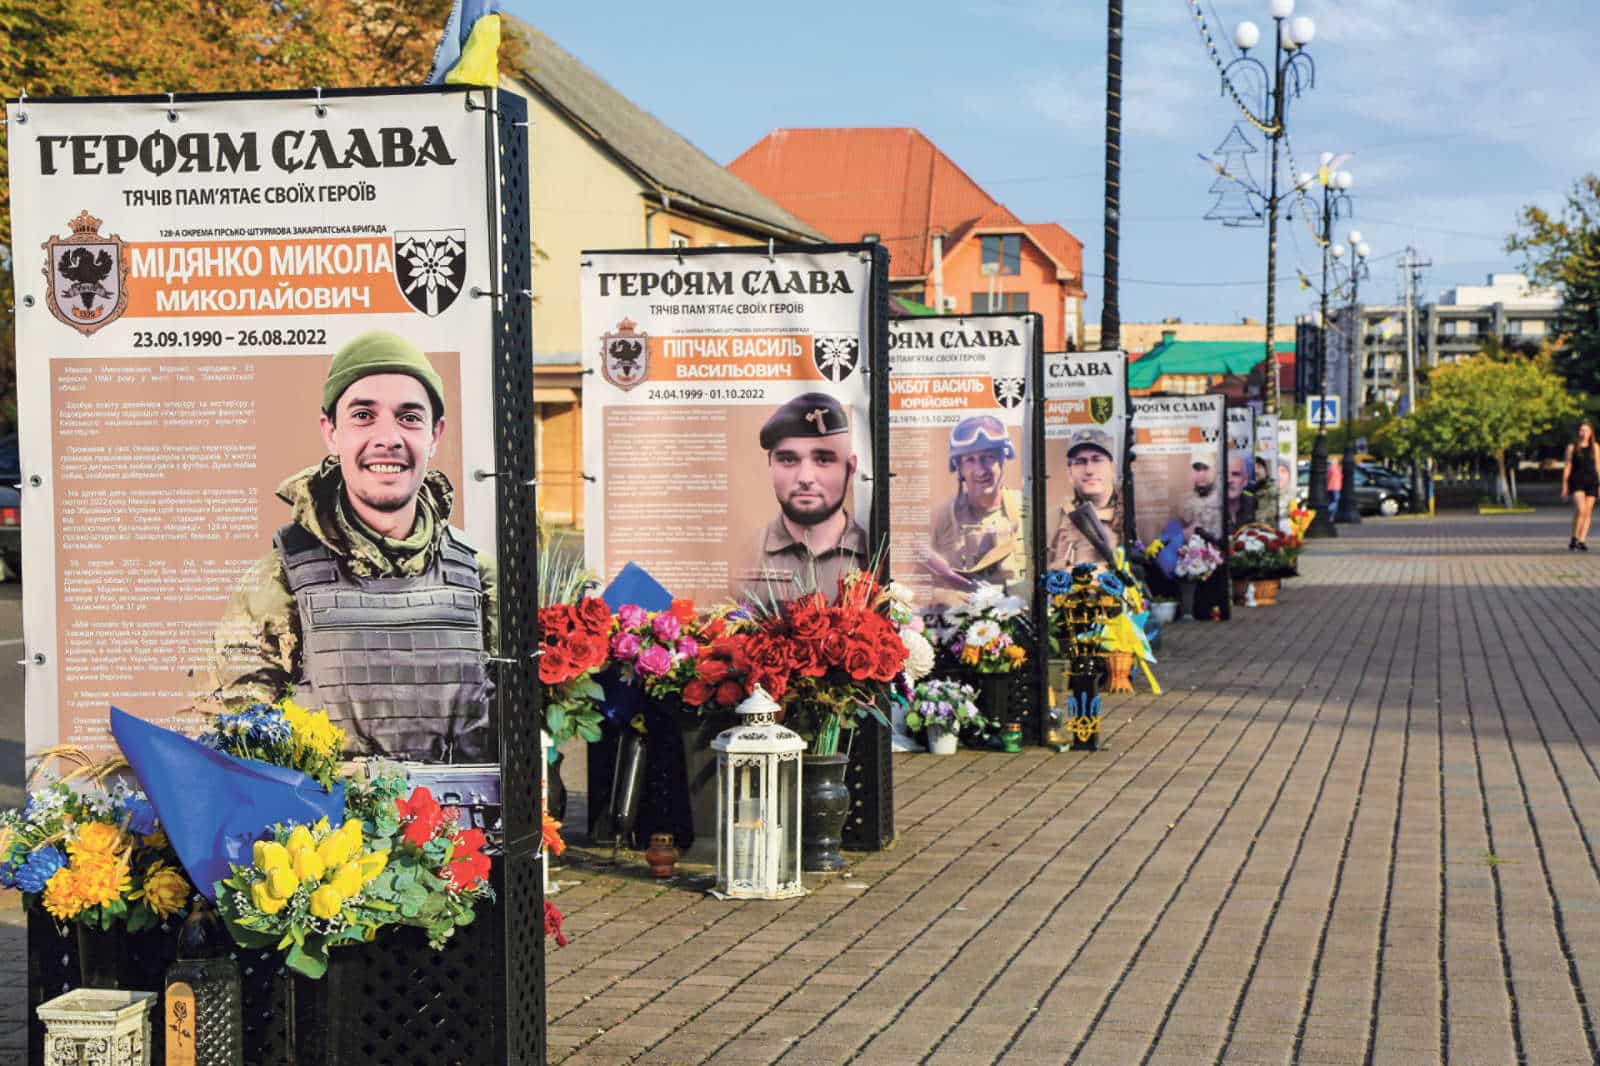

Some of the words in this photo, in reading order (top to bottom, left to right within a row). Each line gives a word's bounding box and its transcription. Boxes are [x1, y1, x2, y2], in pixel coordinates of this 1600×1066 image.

[36, 128, 261, 177] ГЕРОЯМ
[272, 125, 457, 174] СЛАВА
[123, 189, 172, 207] ТЯЧІВ
[175, 185, 261, 206] ПАМ’ЯТАЄ
[264, 182, 316, 205] СВОЇХ
[318, 180, 377, 203] ГЕРОЇВ
[181, 229, 213, 237] ОКРЕМА
[293, 225, 351, 236] ЗАКАРПАТСЬКА
[352, 224, 387, 235] БРИГАДА
[131, 246, 263, 284] МІДЯНКО
[270, 243, 393, 277] МИКОЛА
[599, 270, 734, 297] ГЕРОЯМ
[742, 269, 854, 296] СЛАВА
[156, 282, 371, 313] МИКОЛАЙОВИЧ
[650, 305, 680, 316] ТЯЧІВ
[736, 302, 767, 315] СВОЇХ
[769, 302, 804, 314] ГЕРОЇВ
[133, 331, 222, 348] 23.09.1990
[238, 329, 327, 347] 26.08.2022
[663, 338, 733, 358] ПІПЧАК
[736, 338, 803, 357] ВАСИЛЬ
[940, 329, 1021, 348] СЛАВА
[676, 363, 792, 378] ВАСИЛЬОВИЧ
[1049, 362, 1113, 378] СЛАВА
[649, 389, 703, 400] 24.04.1999
[709, 389, 764, 399] 01.10.2022
[933, 379, 984, 393] ВАСИЛЬ
[1135, 402, 1170, 414] РОЯМ
